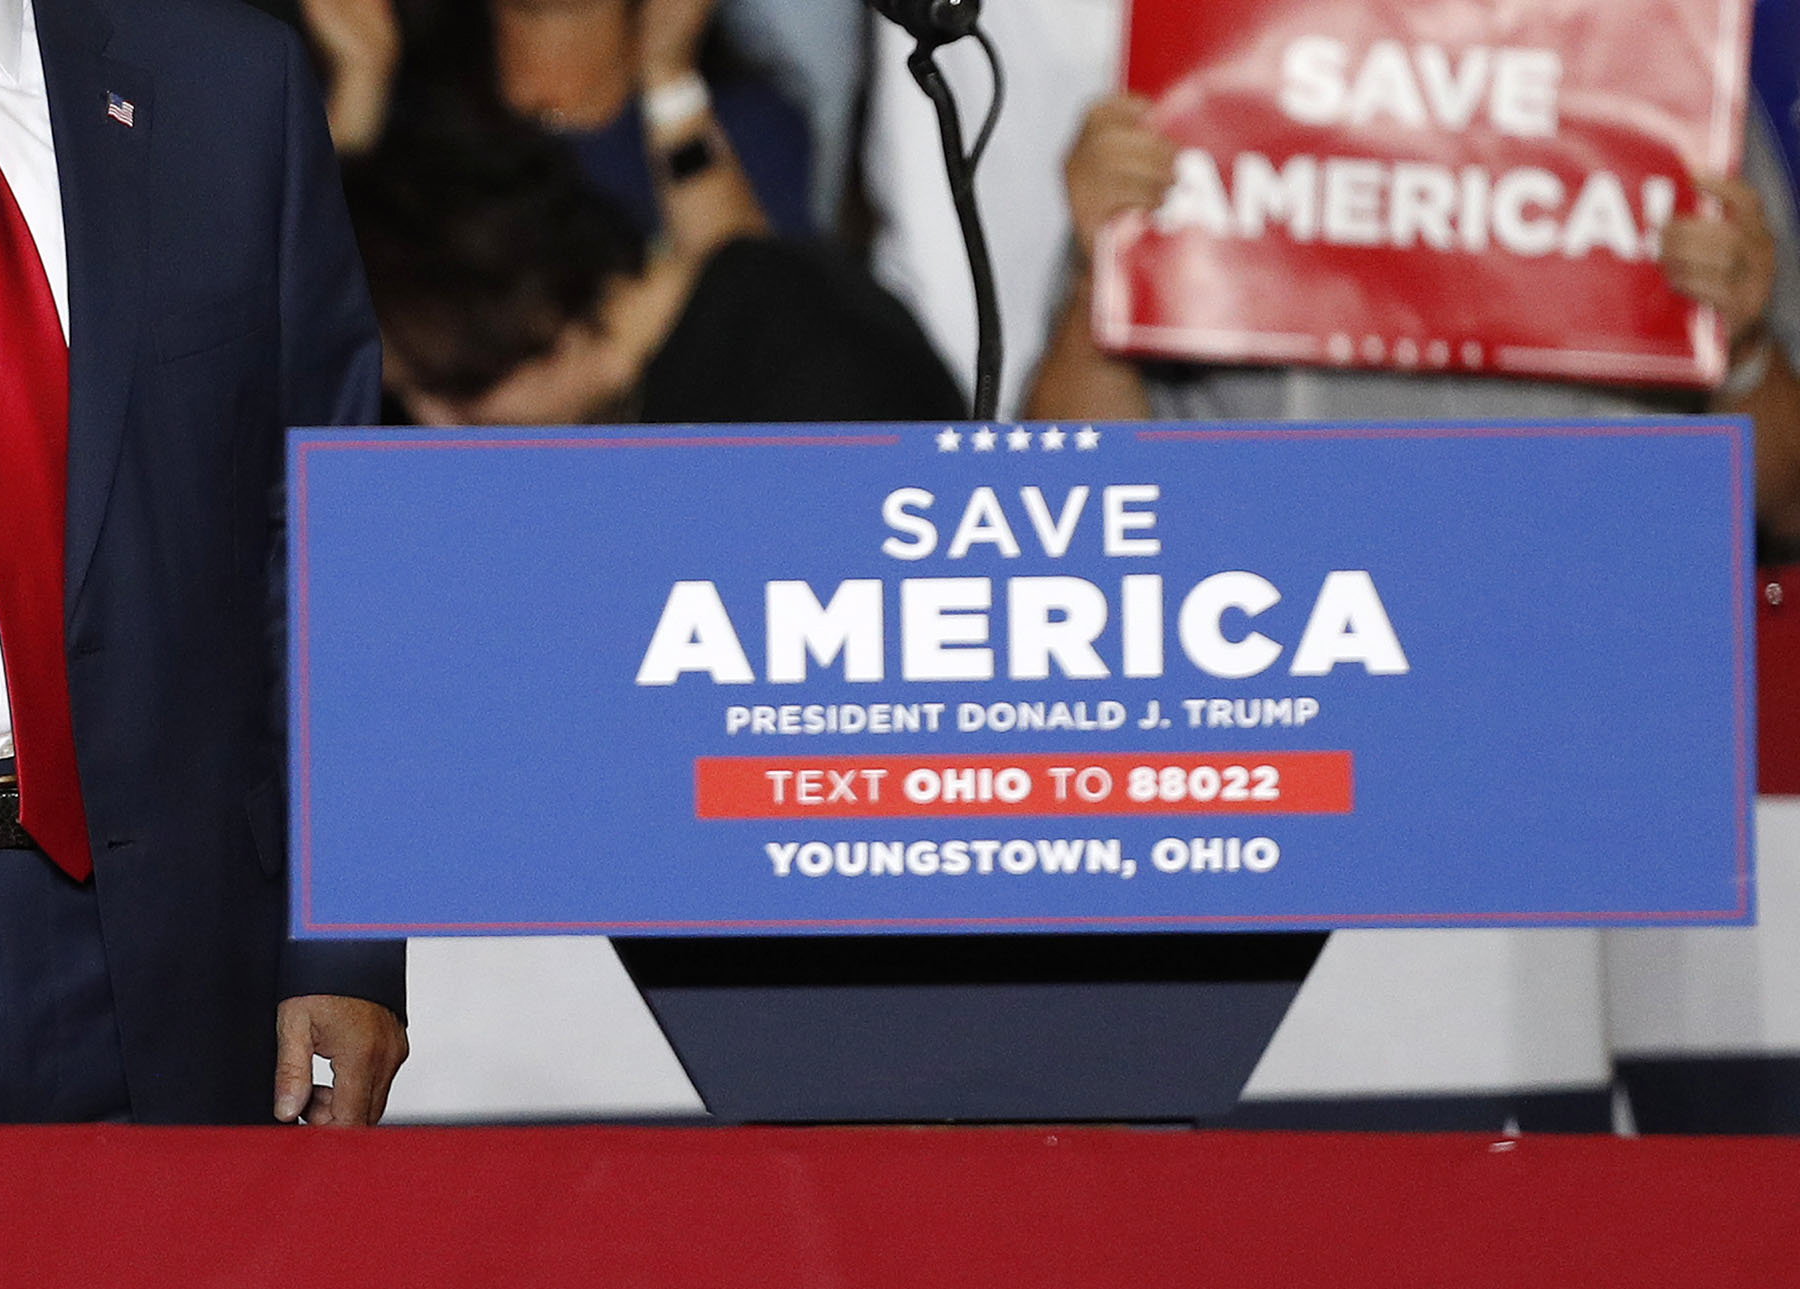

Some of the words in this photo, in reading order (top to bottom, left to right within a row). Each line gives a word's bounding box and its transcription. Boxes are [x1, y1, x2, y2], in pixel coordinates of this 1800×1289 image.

[1280, 34, 1563, 140] SAVE
[1156, 148, 1676, 261] AMERICA!
[881, 483, 1162, 561] SAVE
[635, 569, 1410, 686] AMERICA
[726, 702, 946, 736] PRESIDENT
[957, 699, 1127, 733] DONALD
[1137, 700, 1172, 730] J.
[1183, 697, 1320, 729] TRUMP
[765, 768, 889, 806] TEXT
[903, 766, 1032, 805] OHIO
[1048, 766, 1113, 803] TO
[1126, 764, 1281, 803] 88022
[765, 838, 1137, 880] YOUNGSTOWN,
[1150, 836, 1280, 874] OHIO
